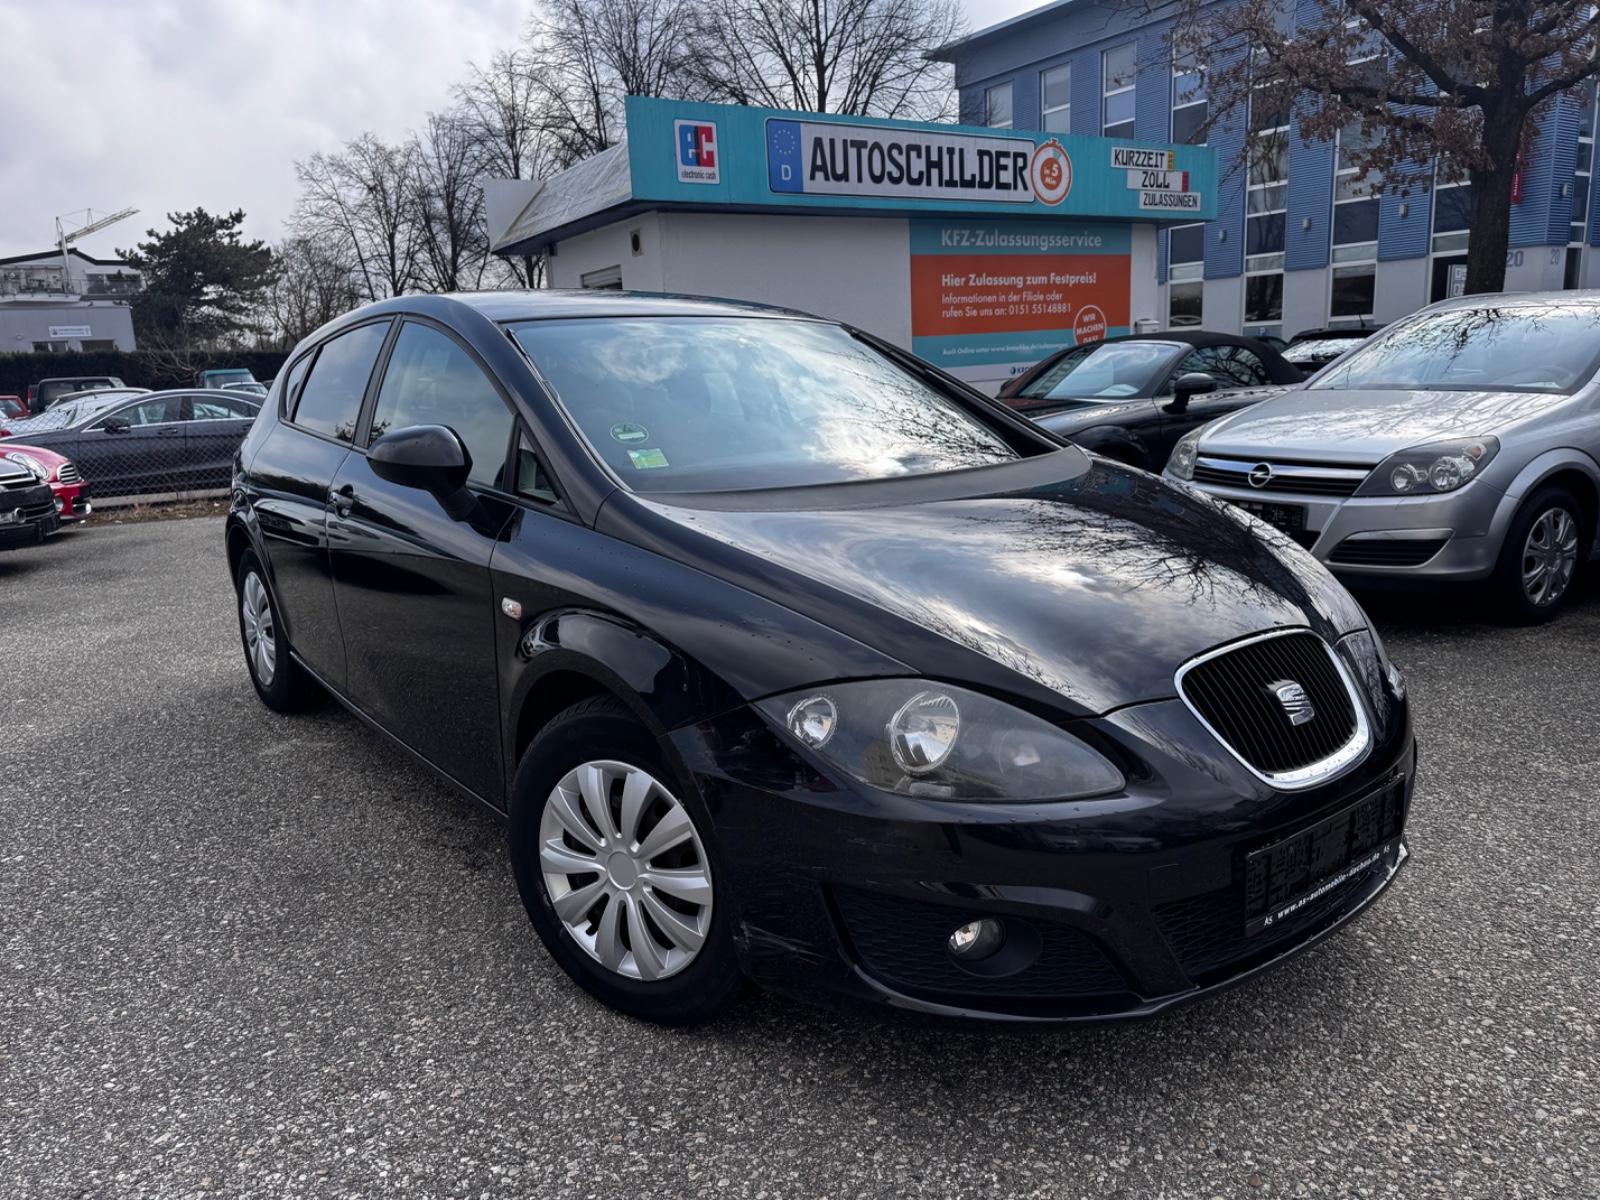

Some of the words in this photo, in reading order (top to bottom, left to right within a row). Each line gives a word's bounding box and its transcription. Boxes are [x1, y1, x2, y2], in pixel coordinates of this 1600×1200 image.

[809, 136, 1029, 191] AUTOSCHILDER
[1113, 149, 1165, 168] KURZZEIT
[781, 164, 792, 180] D
[1051, 164, 1058, 176] 5
[1141, 171, 1170, 188] ZOLL
[1143, 192, 1198, 208] ZULASSUNGEN
[941, 229, 1102, 250] KFZ-Zulassungsservice
[1506, 250, 1524, 267] 20
[942, 274, 965, 287] Hier
[968, 273, 1024, 288] Zulassung
[1026, 275, 1048, 284] zum
[1050, 272, 1097, 287] Festpreis!
[942, 292, 997, 304] Informationen
[999, 292, 1006, 302] in
[1007, 292, 1021, 302] der
[1022, 291, 1044, 301] Filiale
[1045, 292, 1063, 300] oder
[942, 307, 963, 318] rufen
[964, 306, 977, 316] Sie
[979, 308, 993, 316] uns
[994, 308, 1007, 316] an:
[1008, 304, 1029, 315] 0151
[1082, 313, 1096, 322] WIR
[1076, 323, 1104, 336] MACHEN
[1264, 916, 1273, 926] AS
